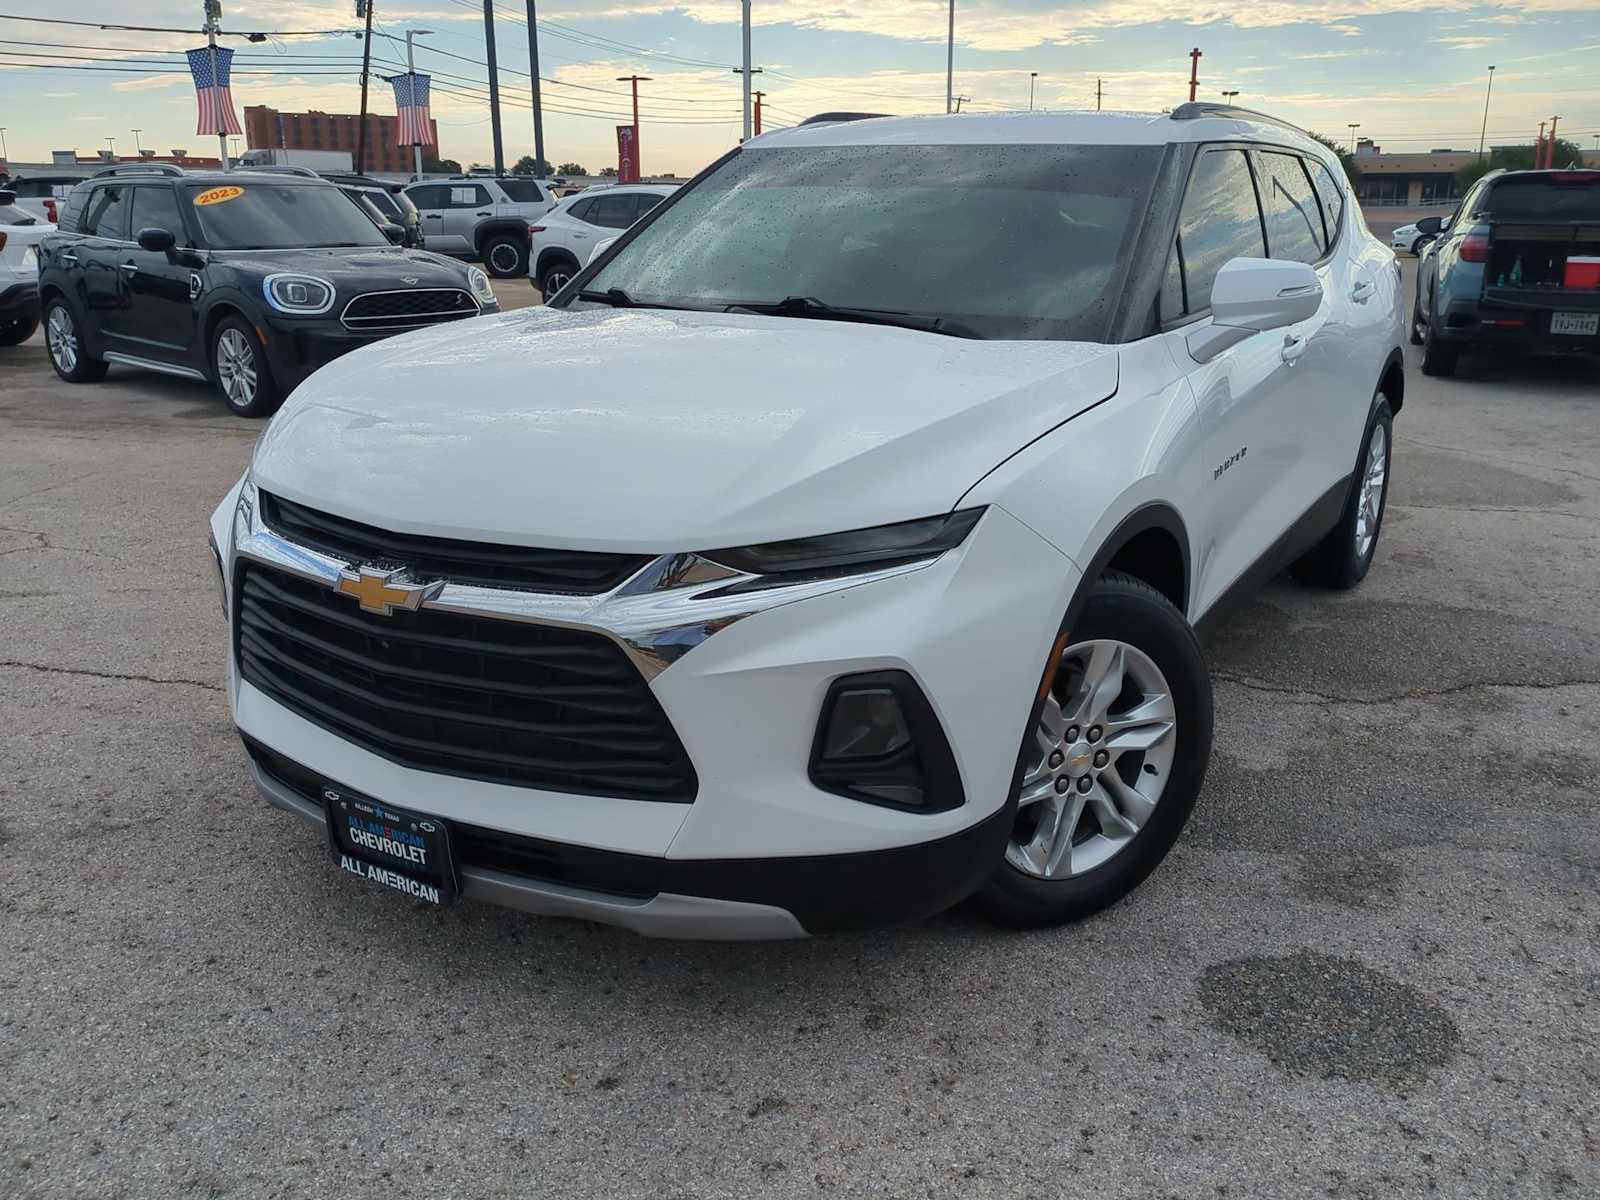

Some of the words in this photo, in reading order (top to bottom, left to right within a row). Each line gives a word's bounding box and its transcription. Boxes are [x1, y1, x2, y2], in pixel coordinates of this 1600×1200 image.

[199, 187, 240, 204] 2023
[348, 815, 365, 831] ALL
[368, 821, 425, 848] AMERICAN
[349, 826, 427, 865] CHEVROLET
[341, 855, 365, 876] ALL
[367, 866, 439, 904] AMERICAN
